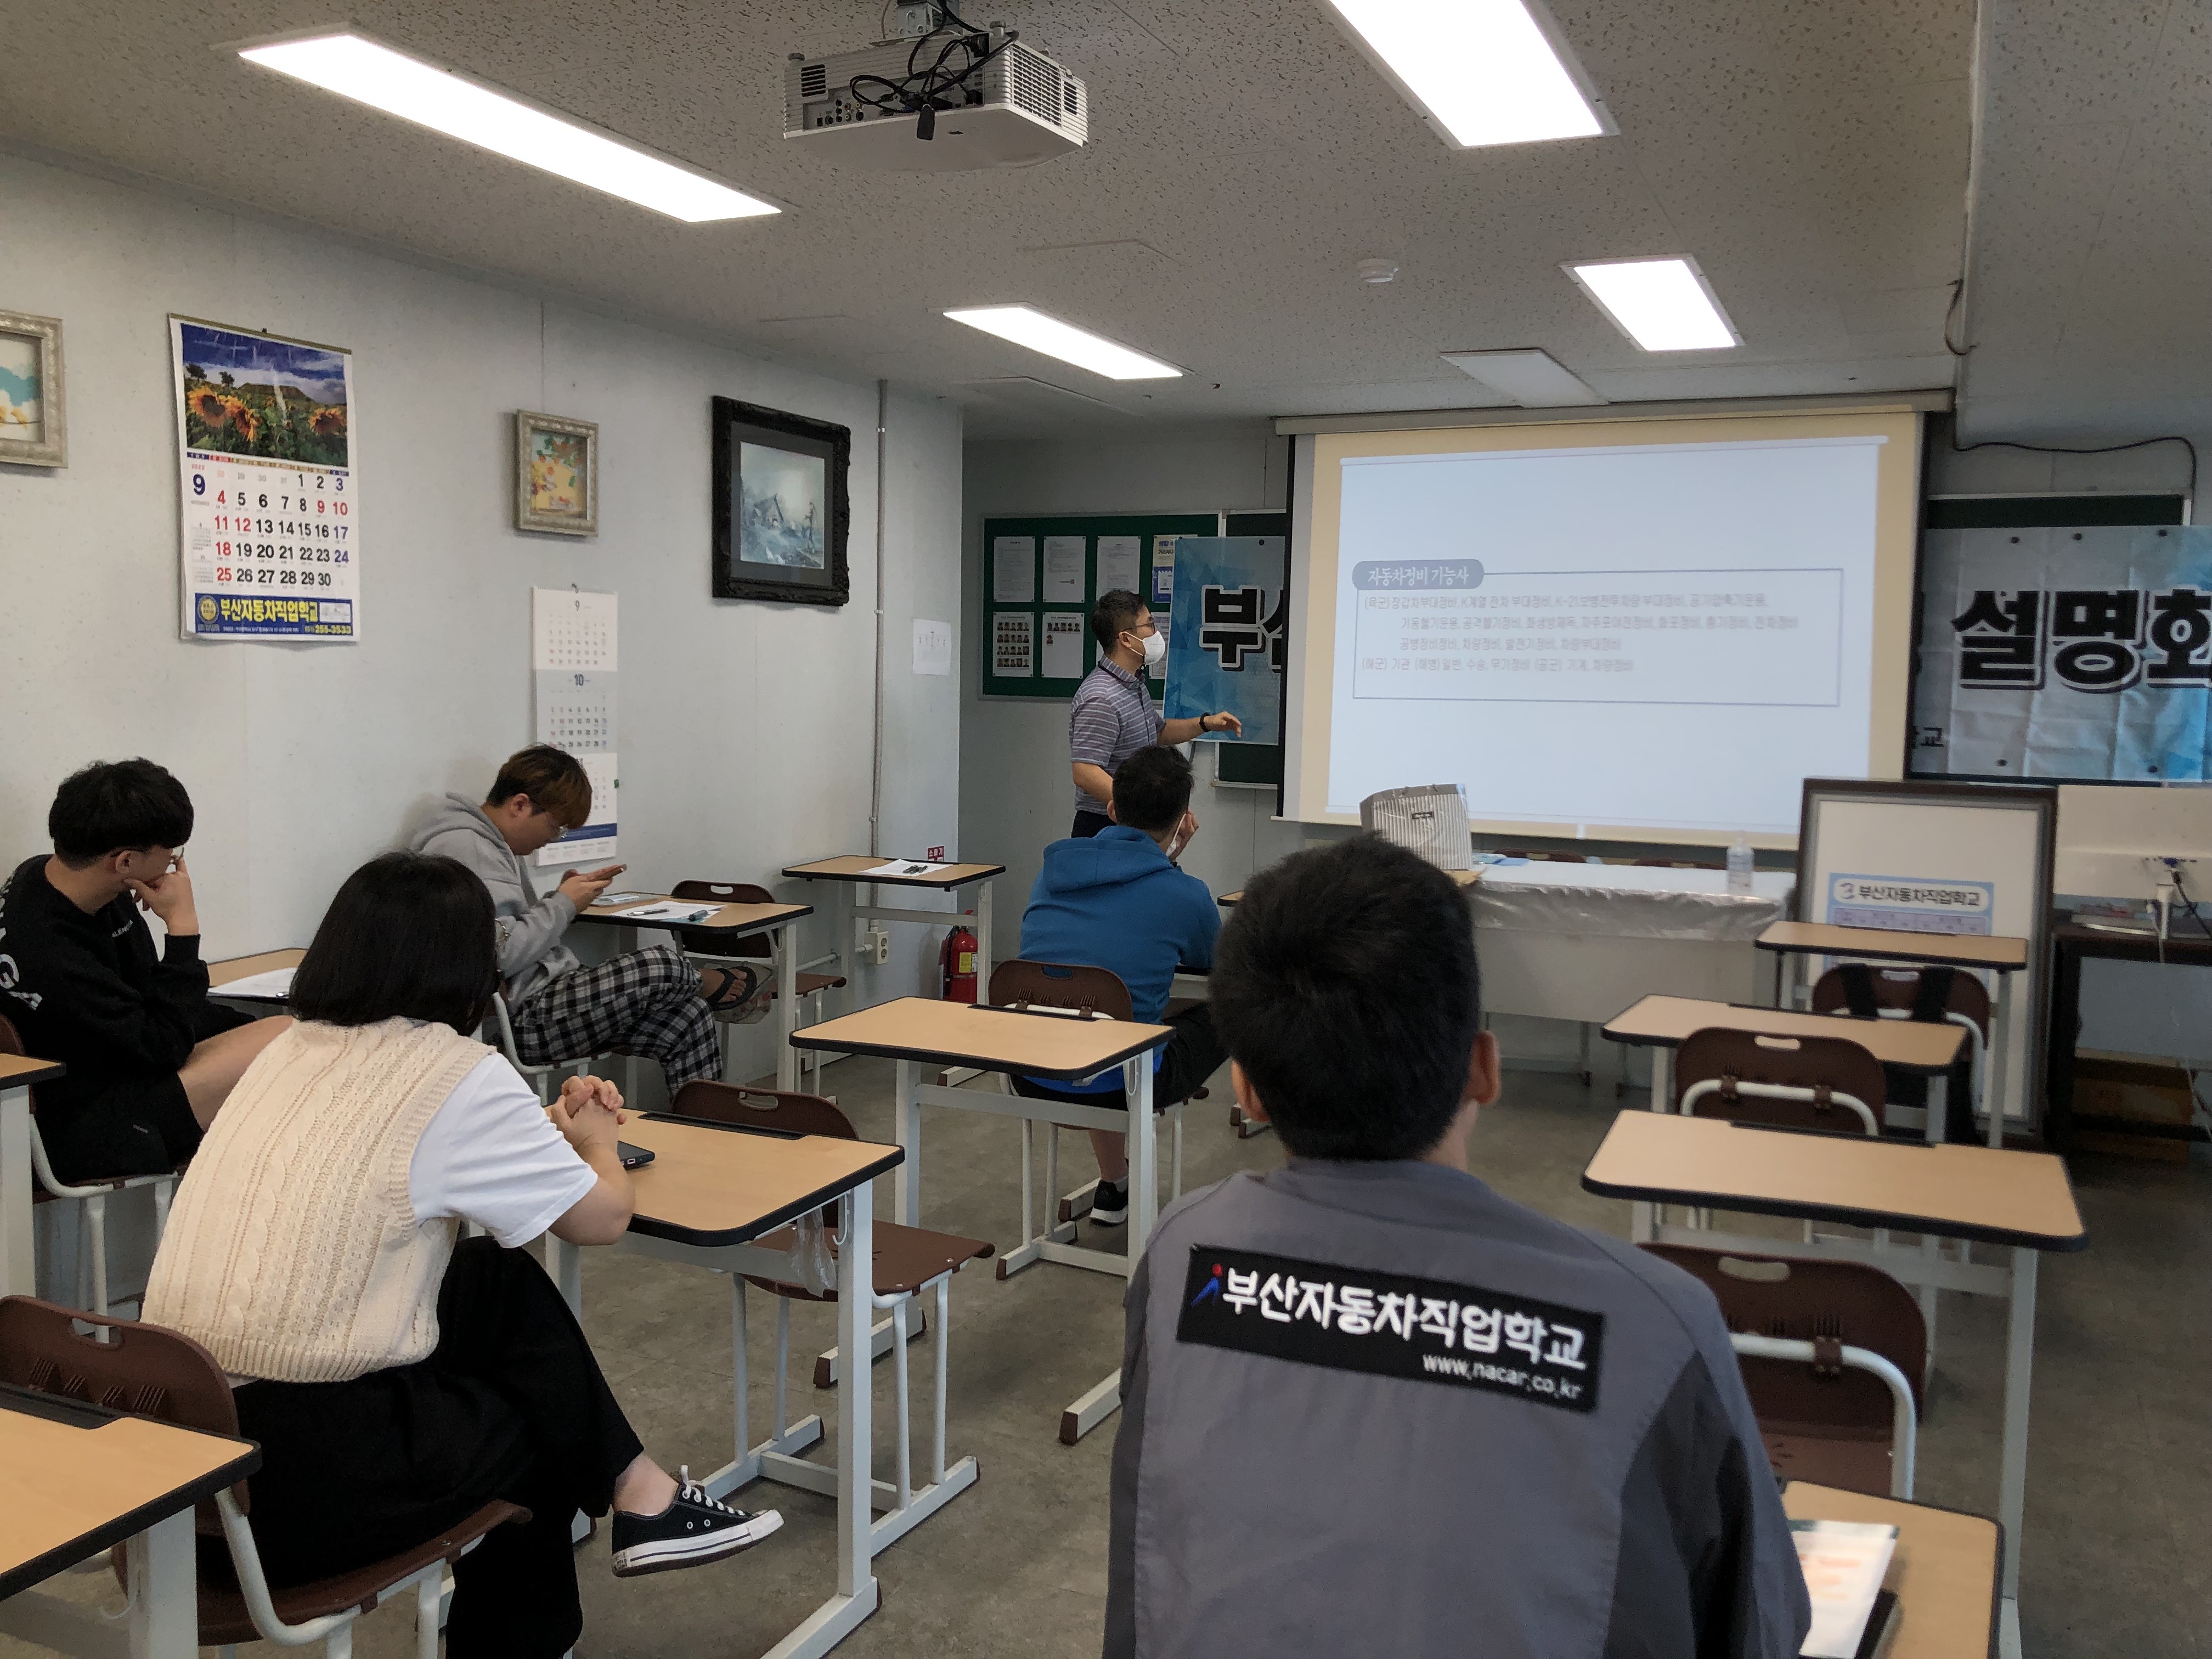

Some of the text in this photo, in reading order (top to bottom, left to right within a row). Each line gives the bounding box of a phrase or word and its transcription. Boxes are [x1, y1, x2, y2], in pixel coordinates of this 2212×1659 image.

[193, 473, 206, 495] 9
[298, 473, 303, 488] 1
[317, 475, 325, 489] 2
[335, 477, 344, 492] 3
[217, 489, 226, 504] 4
[238, 492, 246, 506] 5
[258, 493, 268, 508] 6
[281, 495, 289, 510] 7
[300, 497, 307, 512] 8
[317, 500, 325, 514] 9
[332, 501, 348, 516] 10
[215, 515, 348, 540] 11 12 13 14 15 16 17
[215, 541, 349, 563] 18 19 20 21 22 23 24
[216, 566, 232, 582] 25
[236, 567, 253, 583] 26
[257, 568, 275, 584] 27
[280, 569, 297, 585] 28
[301, 571, 315, 586] 29
[318, 572, 331, 586] 30
[1367, 566, 1470, 586] 자동차정비 기능사
[221, 599, 318, 623] 부산자동차직업학교
[575, 600, 580, 611] 9
[574, 674, 584, 686] 10
[928, 847, 943, 857] 소화기
[1858, 884, 1980, 906] 부산자동차직업학교
[1222, 1267, 1587, 1370] 부산자동차직업학교
[1423, 1355, 1581, 1400] www.nacar.co.kr
